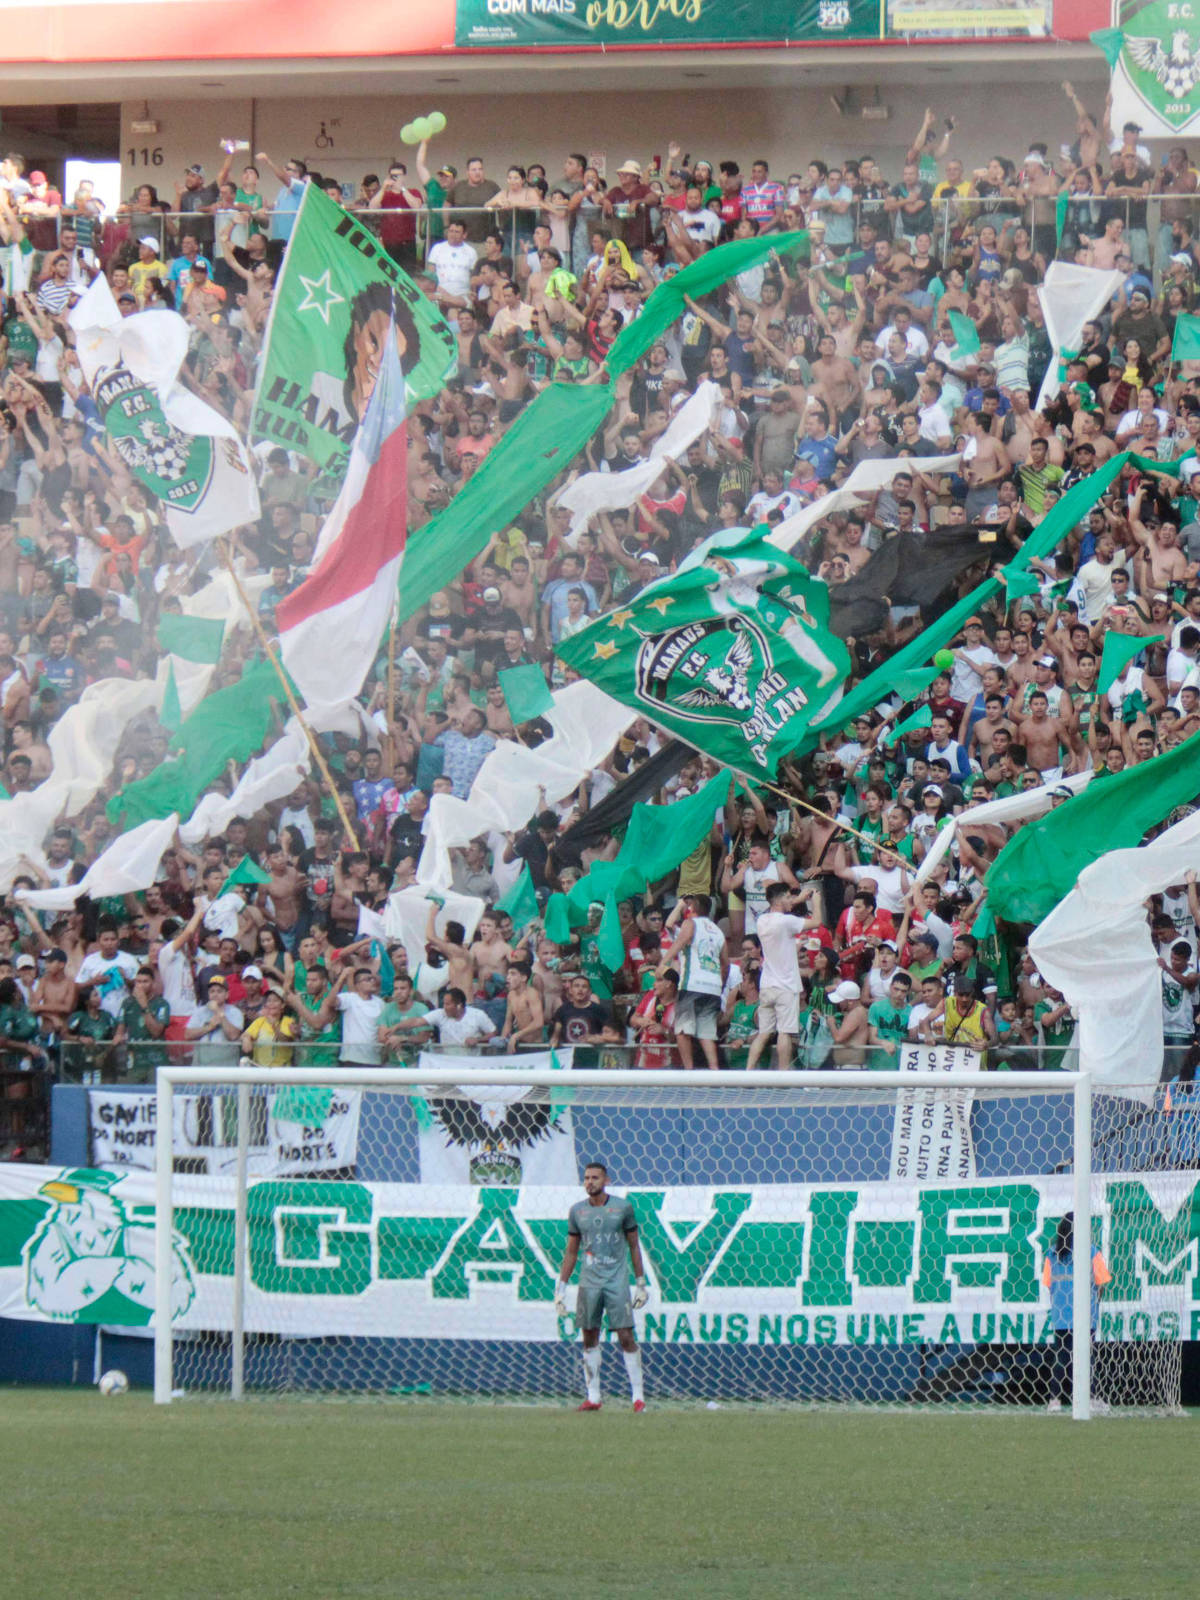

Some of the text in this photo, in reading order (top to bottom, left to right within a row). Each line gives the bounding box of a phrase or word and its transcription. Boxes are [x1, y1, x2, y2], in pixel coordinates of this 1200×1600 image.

[1164, 103, 1191, 114] 2013
[127, 147, 165, 167] 116
[120, 393, 152, 418] F.C.
[167, 480, 199, 500] 2013
[652, 623, 706, 681] MANAUS
[680, 649, 711, 679] F.C.
[896, 1049, 920, 1178] SOU MANAURA
[114, 1128, 157, 1148] NORT
[278, 1142, 338, 1162] NORTE
[937, 1144, 952, 1177] RNA
[957, 1126, 971, 1179] ANAUS
[601, 1312, 749, 1344] NAUS
[758, 1313, 837, 1345] NOS
[939, 1313, 962, 1345] A
[1100, 1310, 1182, 1342] NOS
